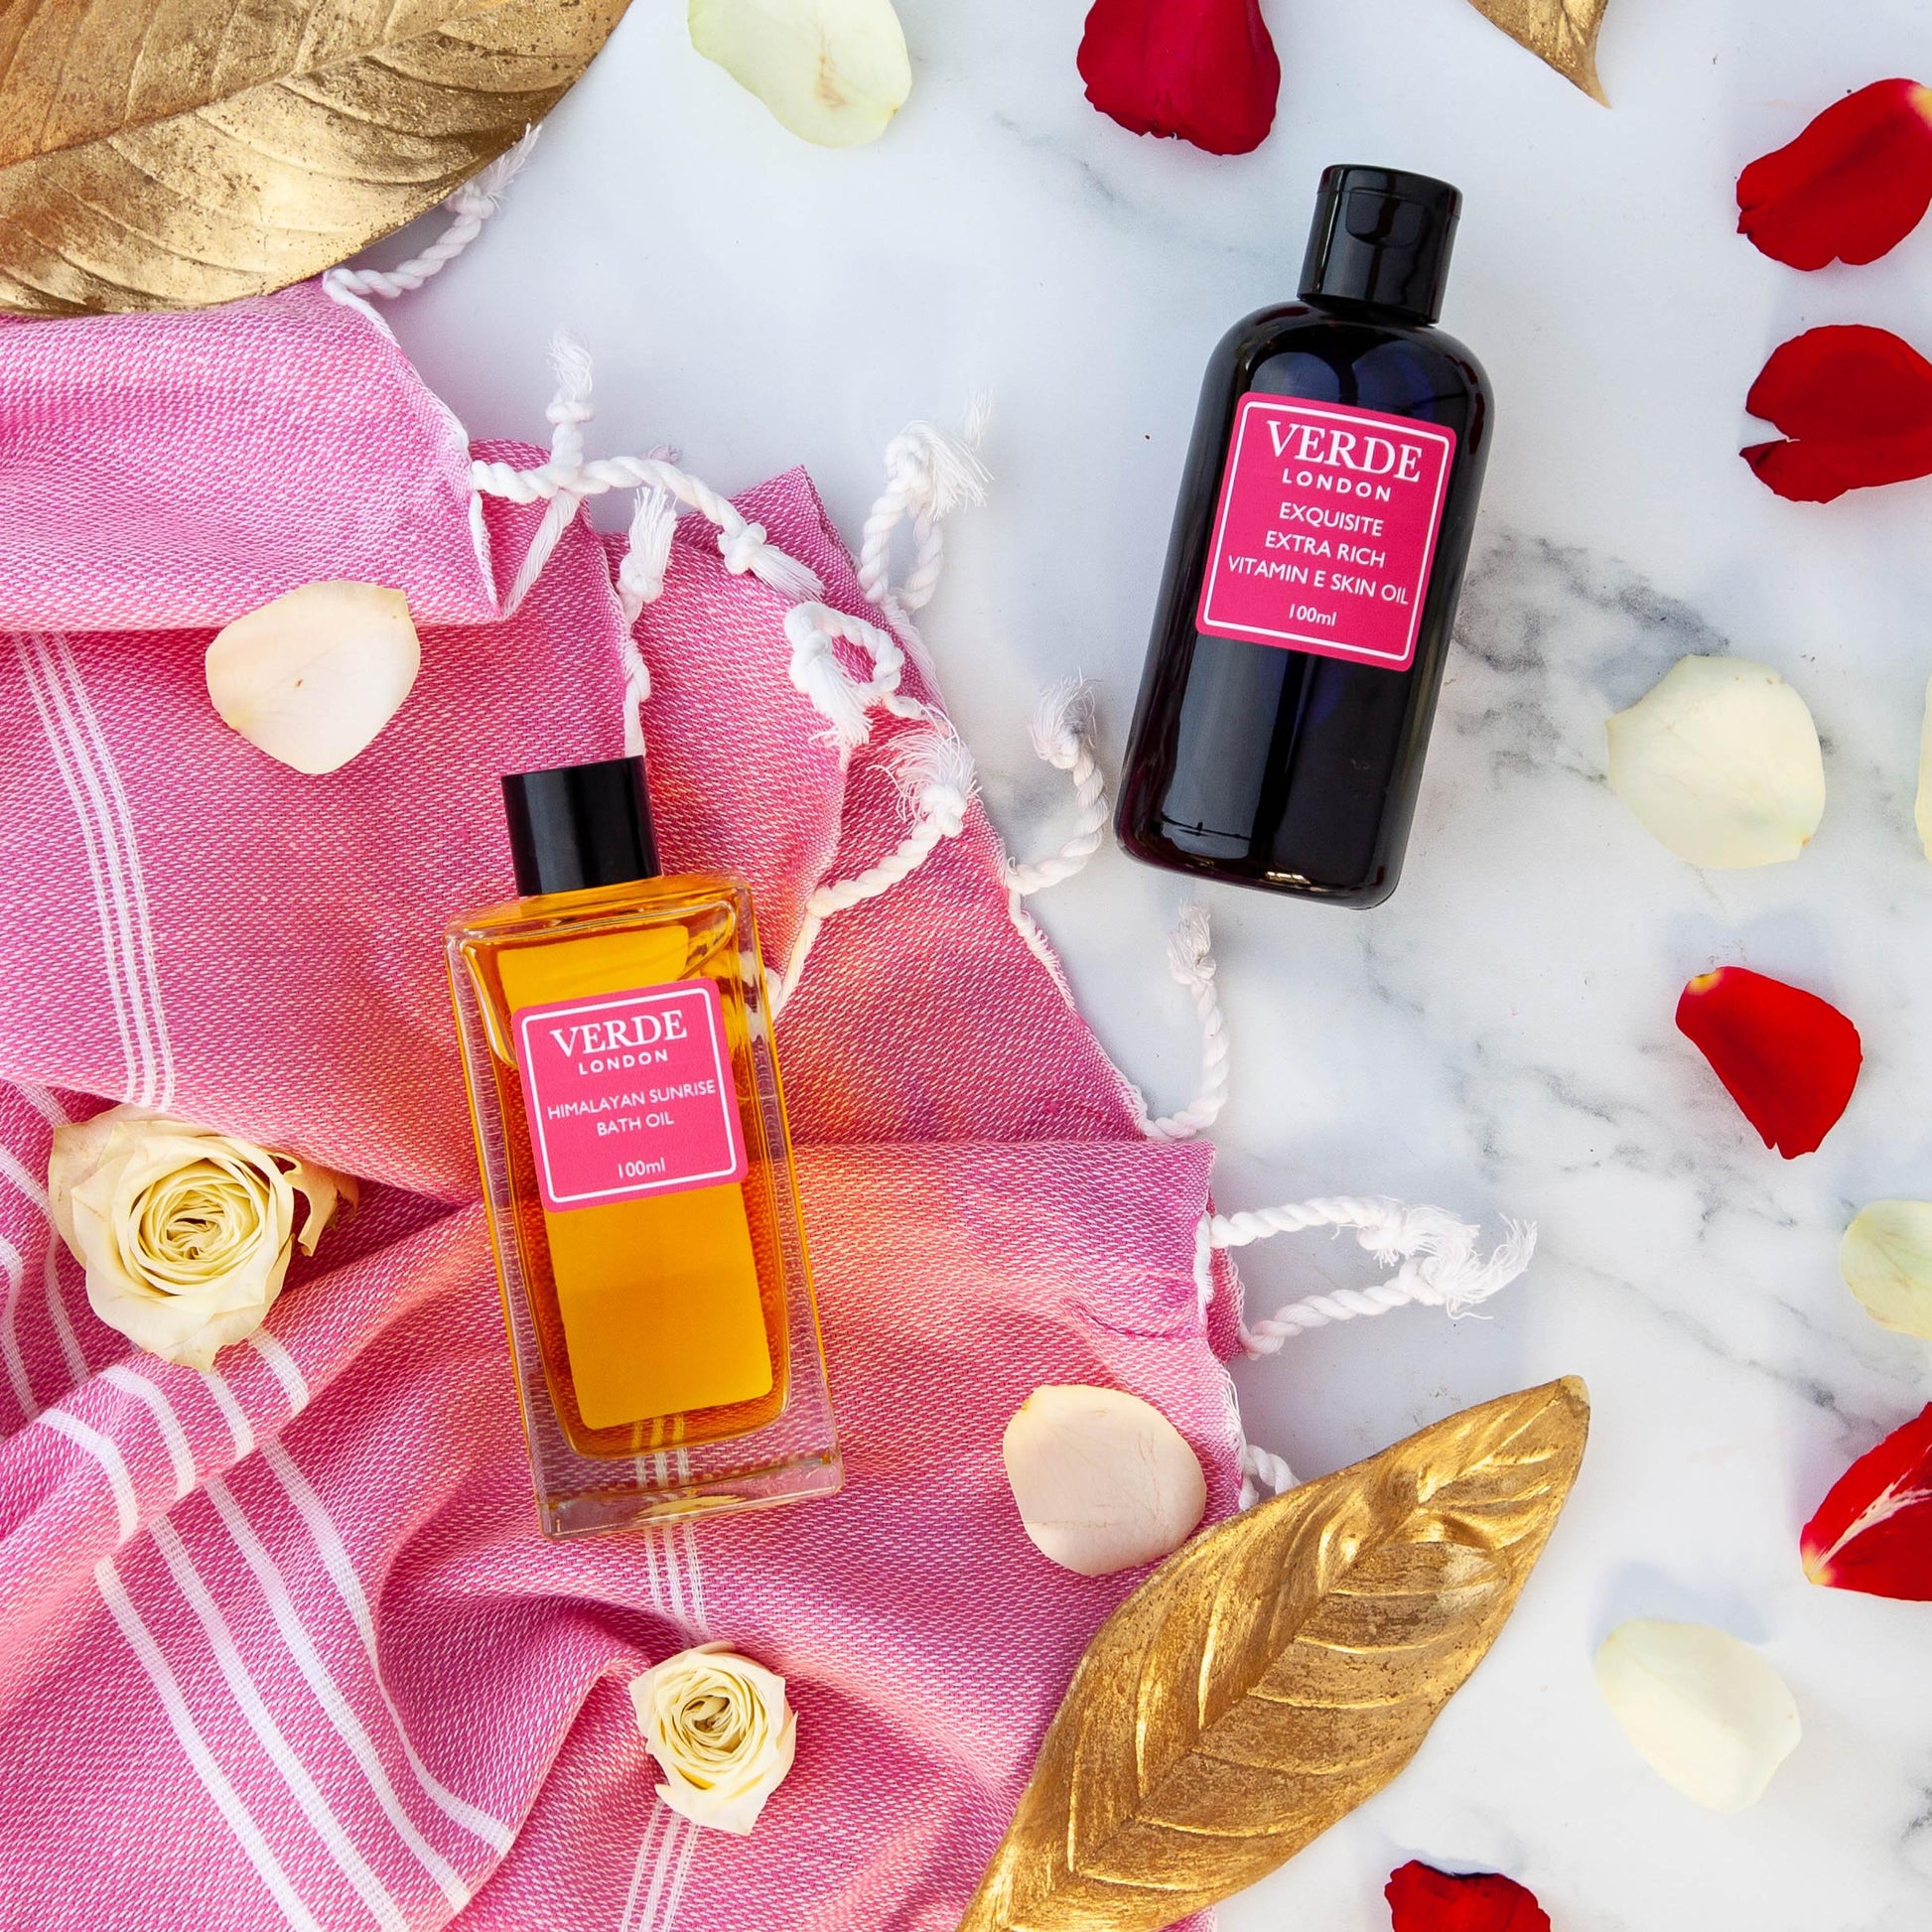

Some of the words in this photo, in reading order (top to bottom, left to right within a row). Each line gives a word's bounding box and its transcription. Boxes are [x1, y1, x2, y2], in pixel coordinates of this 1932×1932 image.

[1266, 419, 1423, 483] VERDE
[1281, 468, 1392, 502] LONDON
[1279, 501, 1385, 537] EXQUISITE
[1264, 530, 1331, 558] EXTRA
[1336, 543, 1386, 569] RICH
[1227, 555, 1309, 585] VITAMIN
[1313, 570, 1326, 588] E
[1330, 573, 1377, 599] SKIN
[1381, 584, 1409, 606] OIL
[1288, 603, 1337, 627] 100ml
[549, 1009, 688, 1058] VERDE
[578, 1048, 669, 1076] LONDON
[547, 1090, 646, 1121] HIMALAYAN
[649, 1079, 717, 1104] SUNRISE
[596, 1117, 642, 1137] BATH
[645, 1111, 675, 1128] OIL
[618, 1157, 666, 1179] 100ml
